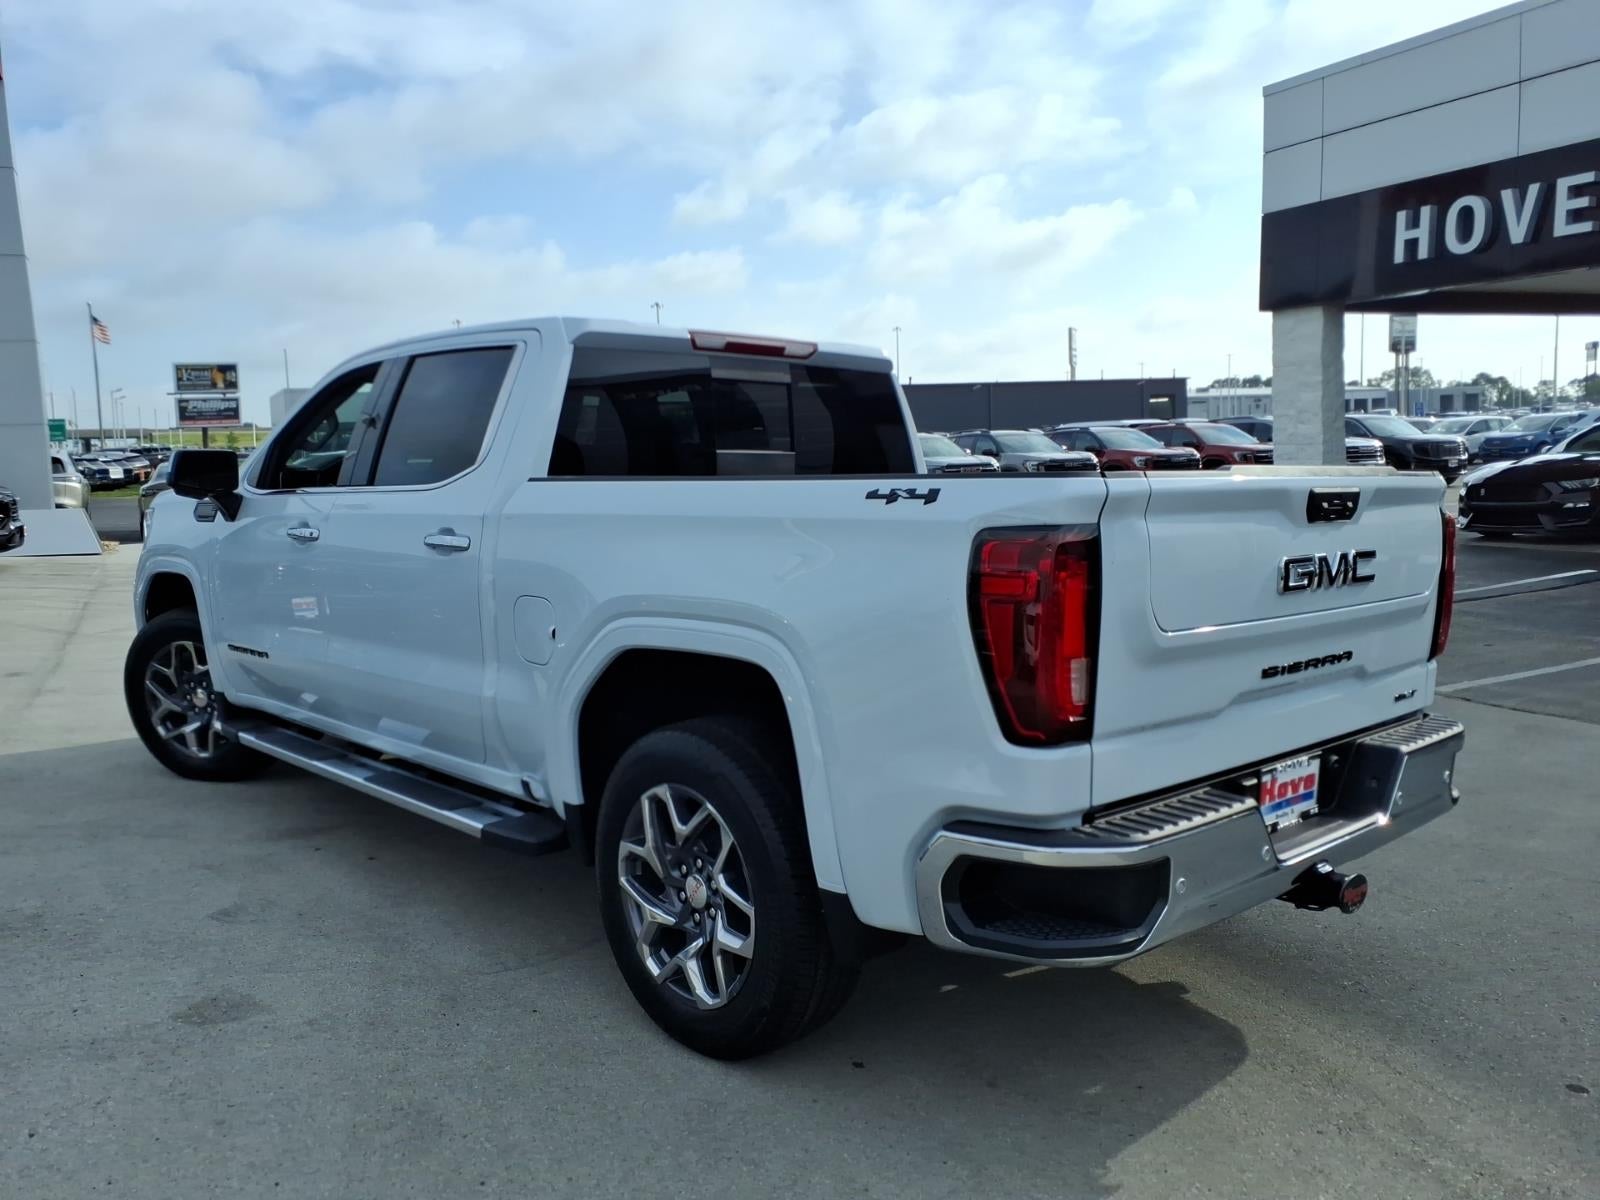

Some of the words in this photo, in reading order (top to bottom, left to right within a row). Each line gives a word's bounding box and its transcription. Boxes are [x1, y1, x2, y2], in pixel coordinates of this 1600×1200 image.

[1393, 170, 1600, 265] HOVE
[187, 399, 238, 410] Phillips
[1277, 549, 1377, 595] GMC
[1261, 650, 1354, 679] SIERRA
[1260, 772, 1317, 806] Hove
